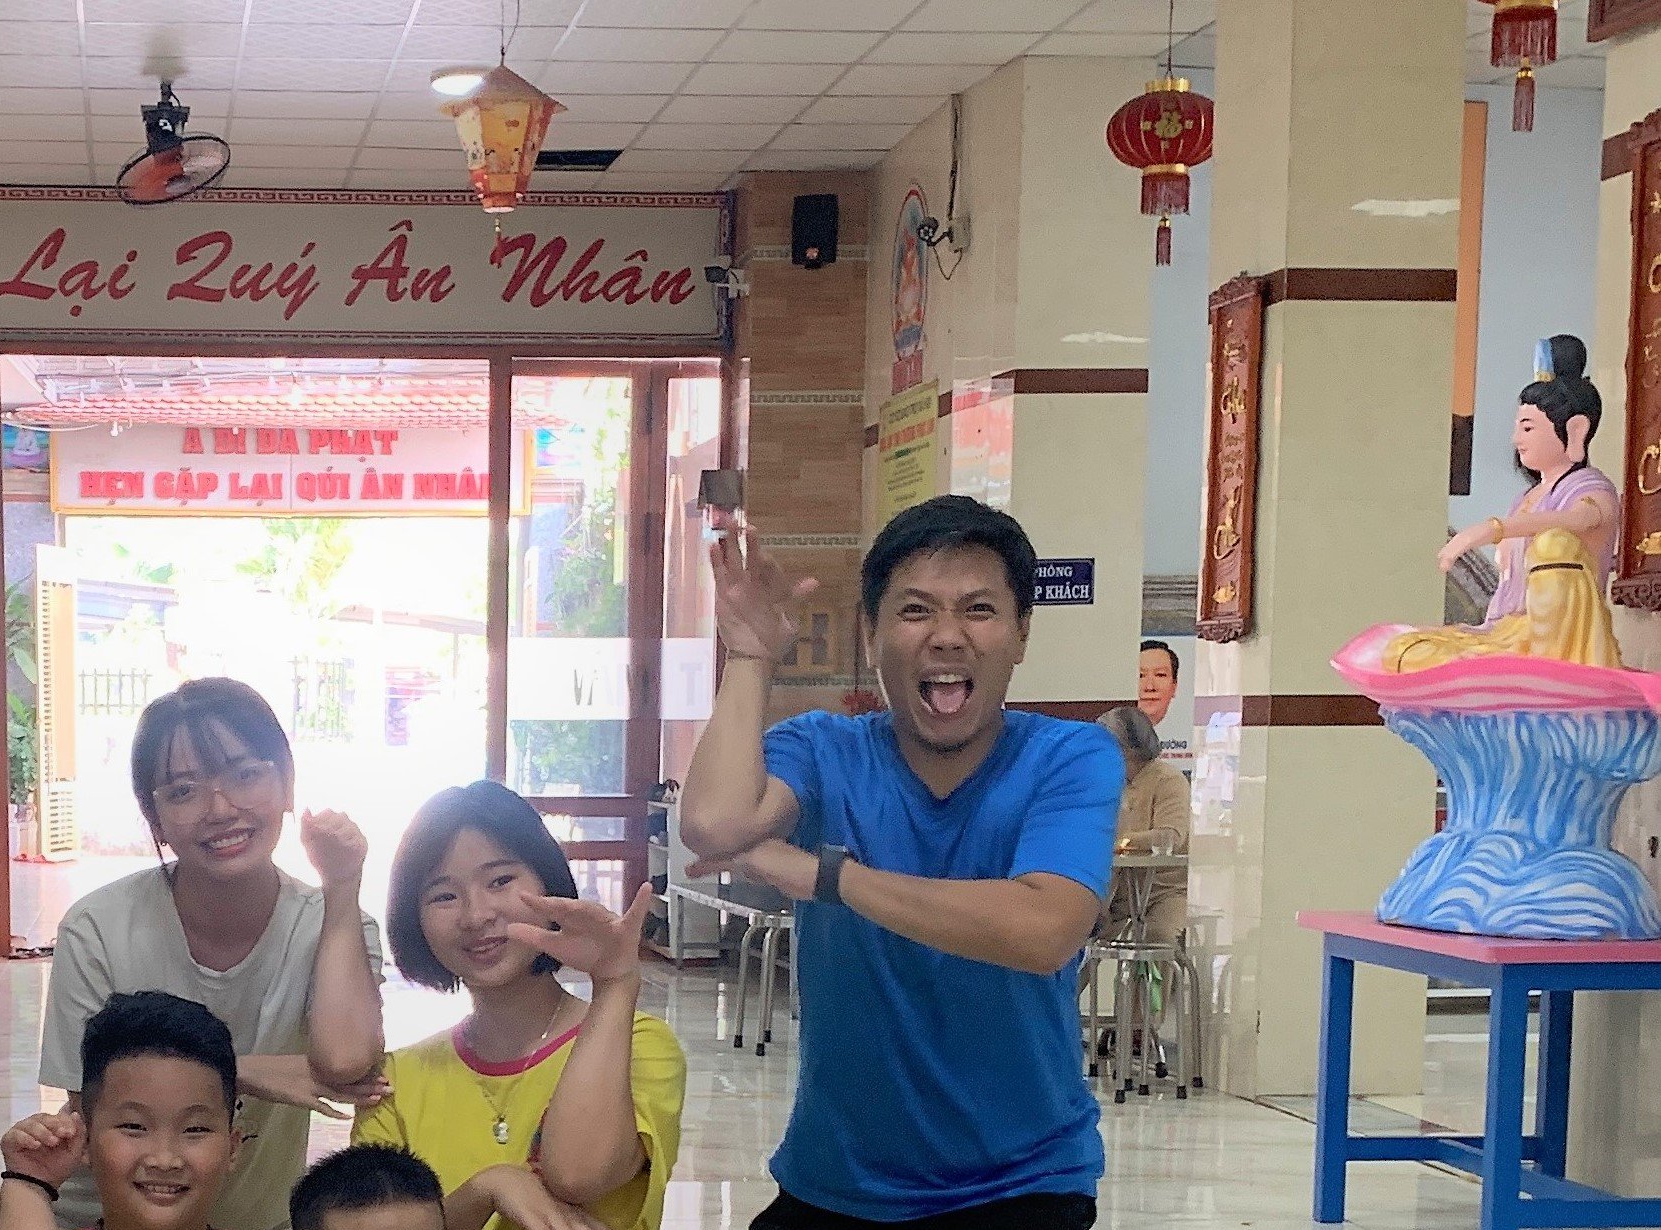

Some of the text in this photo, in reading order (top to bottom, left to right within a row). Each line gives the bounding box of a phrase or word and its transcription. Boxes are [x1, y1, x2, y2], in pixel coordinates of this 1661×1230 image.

[167, 230, 320, 320] Quý
[344, 219, 455, 307] Ân
[489, 233, 696, 307] Nhân
[79, 471, 144, 506] HẸN
[228, 472, 283, 507] LẠI
[359, 466, 404, 500] ÂN
[1034, 564, 1073, 578] HÒNG
[1045, 581, 1090, 600] KHÁCH
